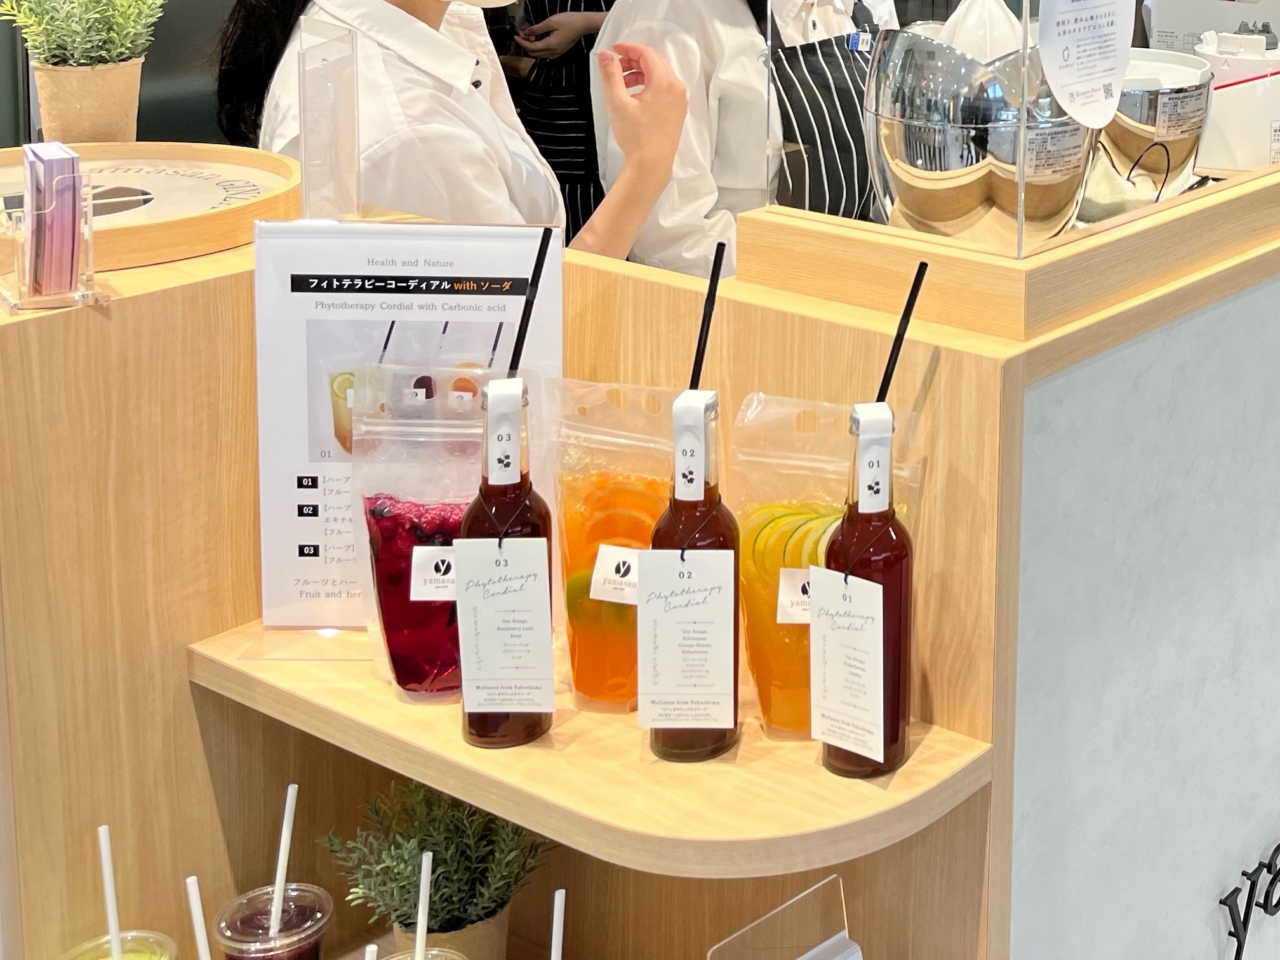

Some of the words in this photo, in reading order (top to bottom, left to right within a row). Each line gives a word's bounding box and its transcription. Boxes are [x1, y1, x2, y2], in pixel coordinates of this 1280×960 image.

[367, 258, 397, 266] Health
[401, 259, 419, 267] and
[423, 259, 454, 267] Nature
[309, 278, 451, 290] フィトテラピーコーディアル
[453, 281, 477, 290] with
[480, 280, 512, 291] ソーダ
[315, 301, 376, 311] Phytotherapy
[380, 302, 413, 310] Cordial
[441, 303, 482, 311] Carbonic
[497, 433, 511, 442] 03
[320, 450, 331, 458] 01
[682, 448, 695, 457] 02
[868, 460, 880, 468] 01
[303, 546, 314, 554] 03
[494, 559, 508, 567] 03
[678, 571, 692, 579] 02
[423, 578, 455, 586] yamasa
[602, 577, 637, 588] yamasan
[299, 590, 320, 598] Fruit
[325, 590, 342, 598] and
[646, 585, 723, 604] Phytotherapy
[842, 593, 852, 603] 01
